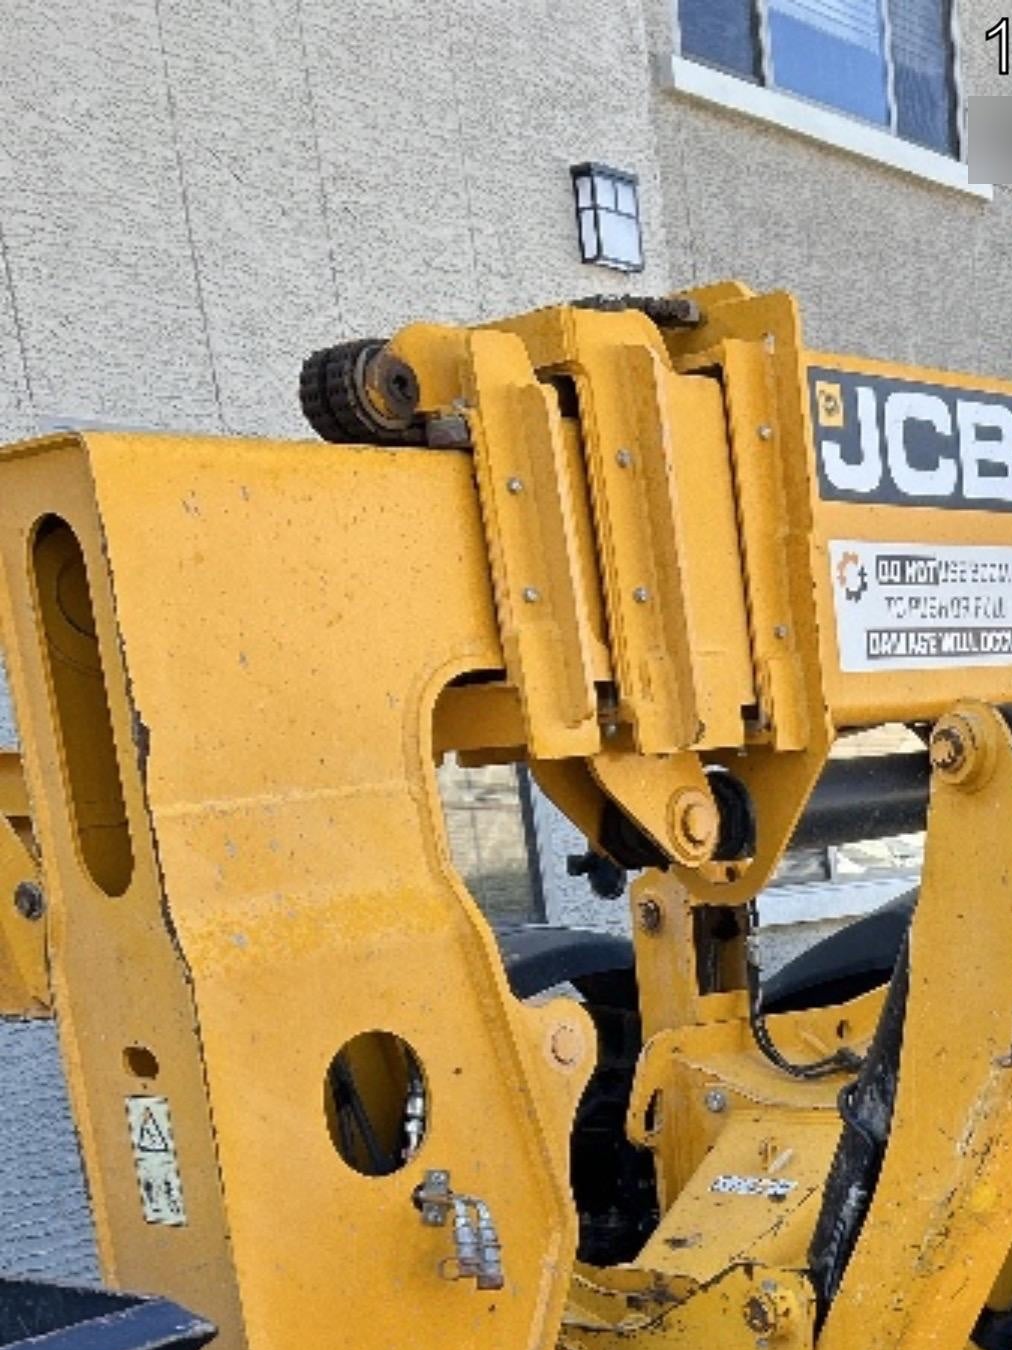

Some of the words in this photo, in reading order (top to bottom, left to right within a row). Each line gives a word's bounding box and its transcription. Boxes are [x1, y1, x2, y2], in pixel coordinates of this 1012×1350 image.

[878, 560, 901, 583] DO
[904, 560, 937, 584] NOT
[868, 631, 938, 656] DAMAGE
[940, 630, 978, 654] WILL
